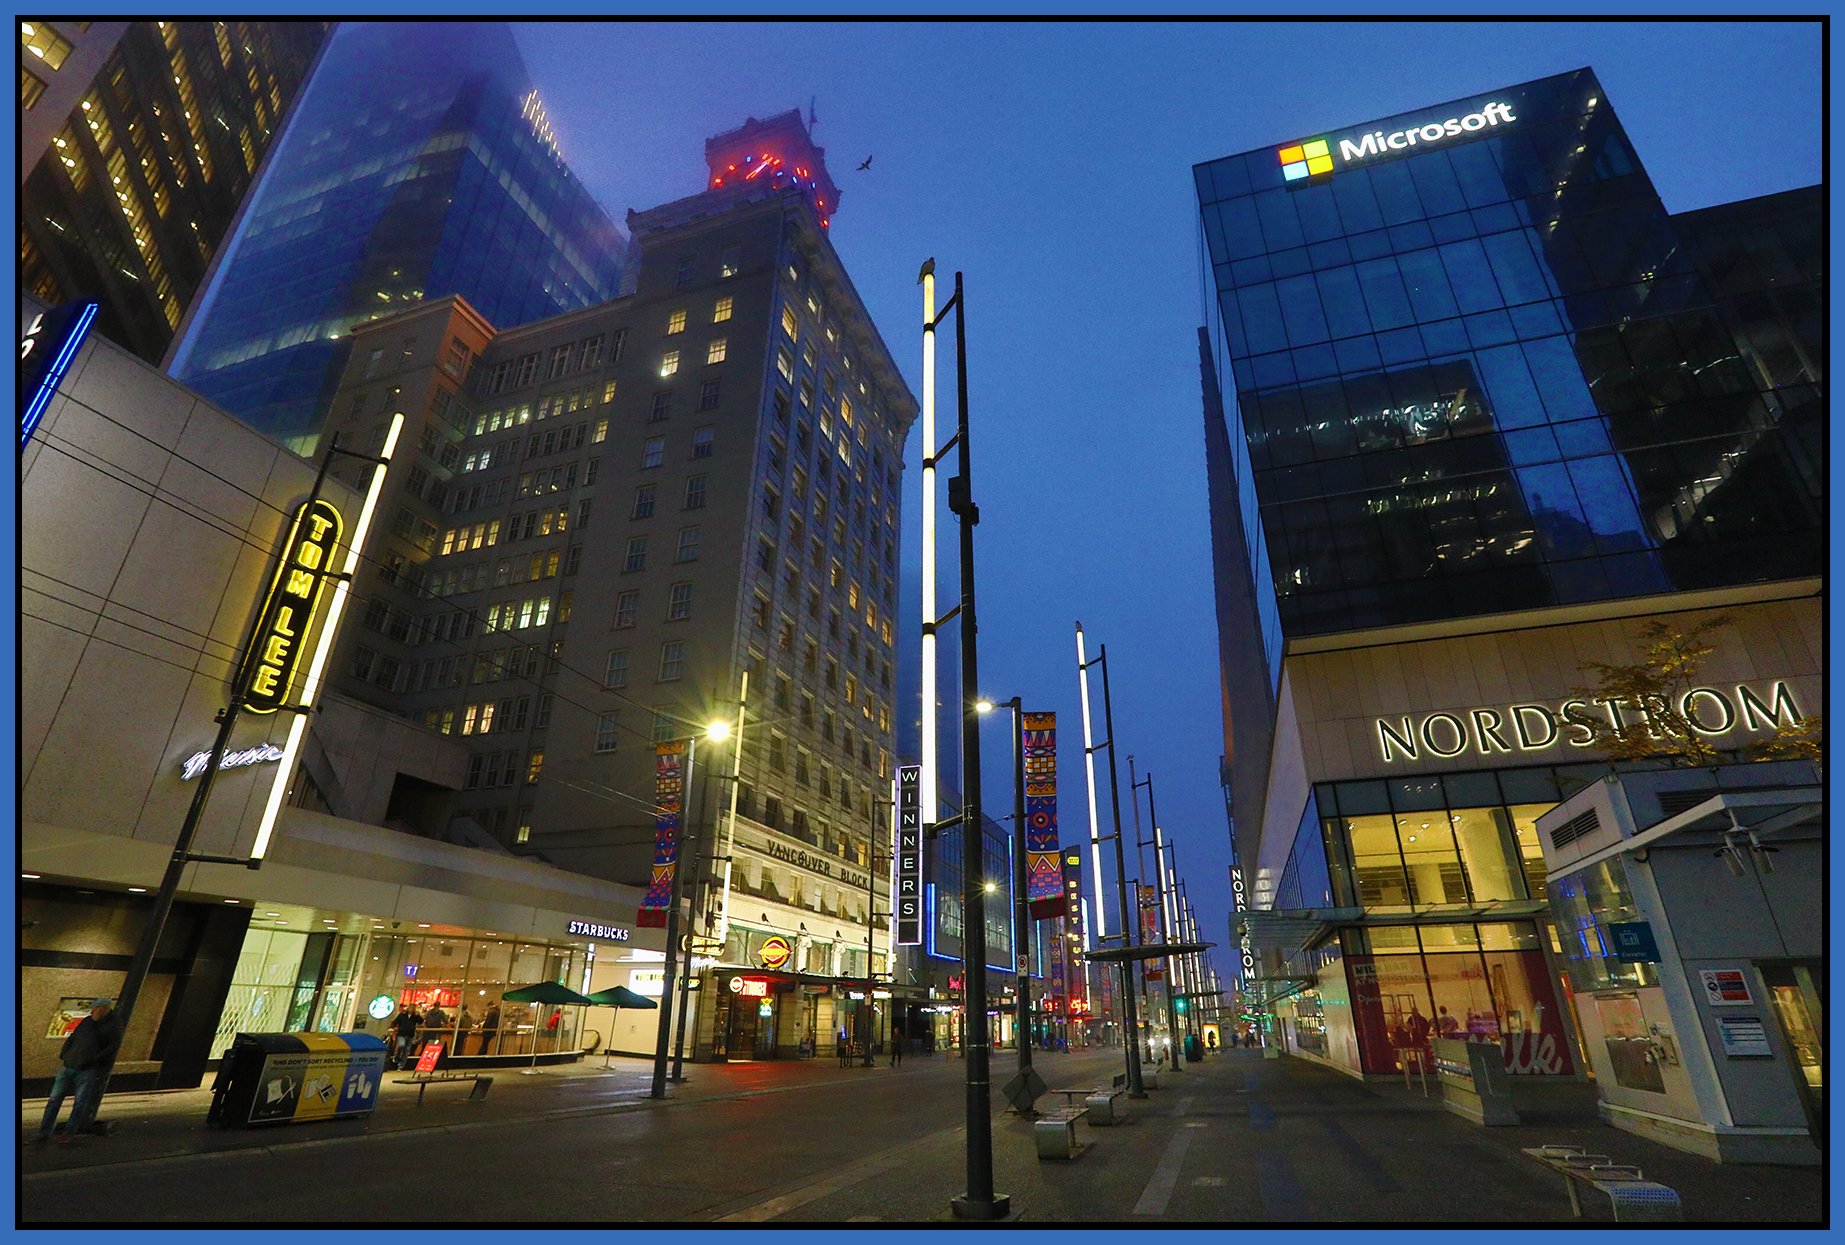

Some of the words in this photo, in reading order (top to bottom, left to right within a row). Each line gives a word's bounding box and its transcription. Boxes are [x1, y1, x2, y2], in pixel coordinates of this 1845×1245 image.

[1339, 102, 1517, 161] Microsoft
[286, 513, 333, 599] TOM
[252, 606, 294, 697] LEE
[1376, 680, 1806, 763] NORDSTROM
[767, 839, 831, 876] VANCOUVER
[840, 867, 869, 890] BLOCK
[901, 770, 918, 915] WINNERS
[568, 920, 629, 941] STARBUCKS
[1068, 880, 1079, 925] BEST
[1072, 933, 1082, 967] BUY
